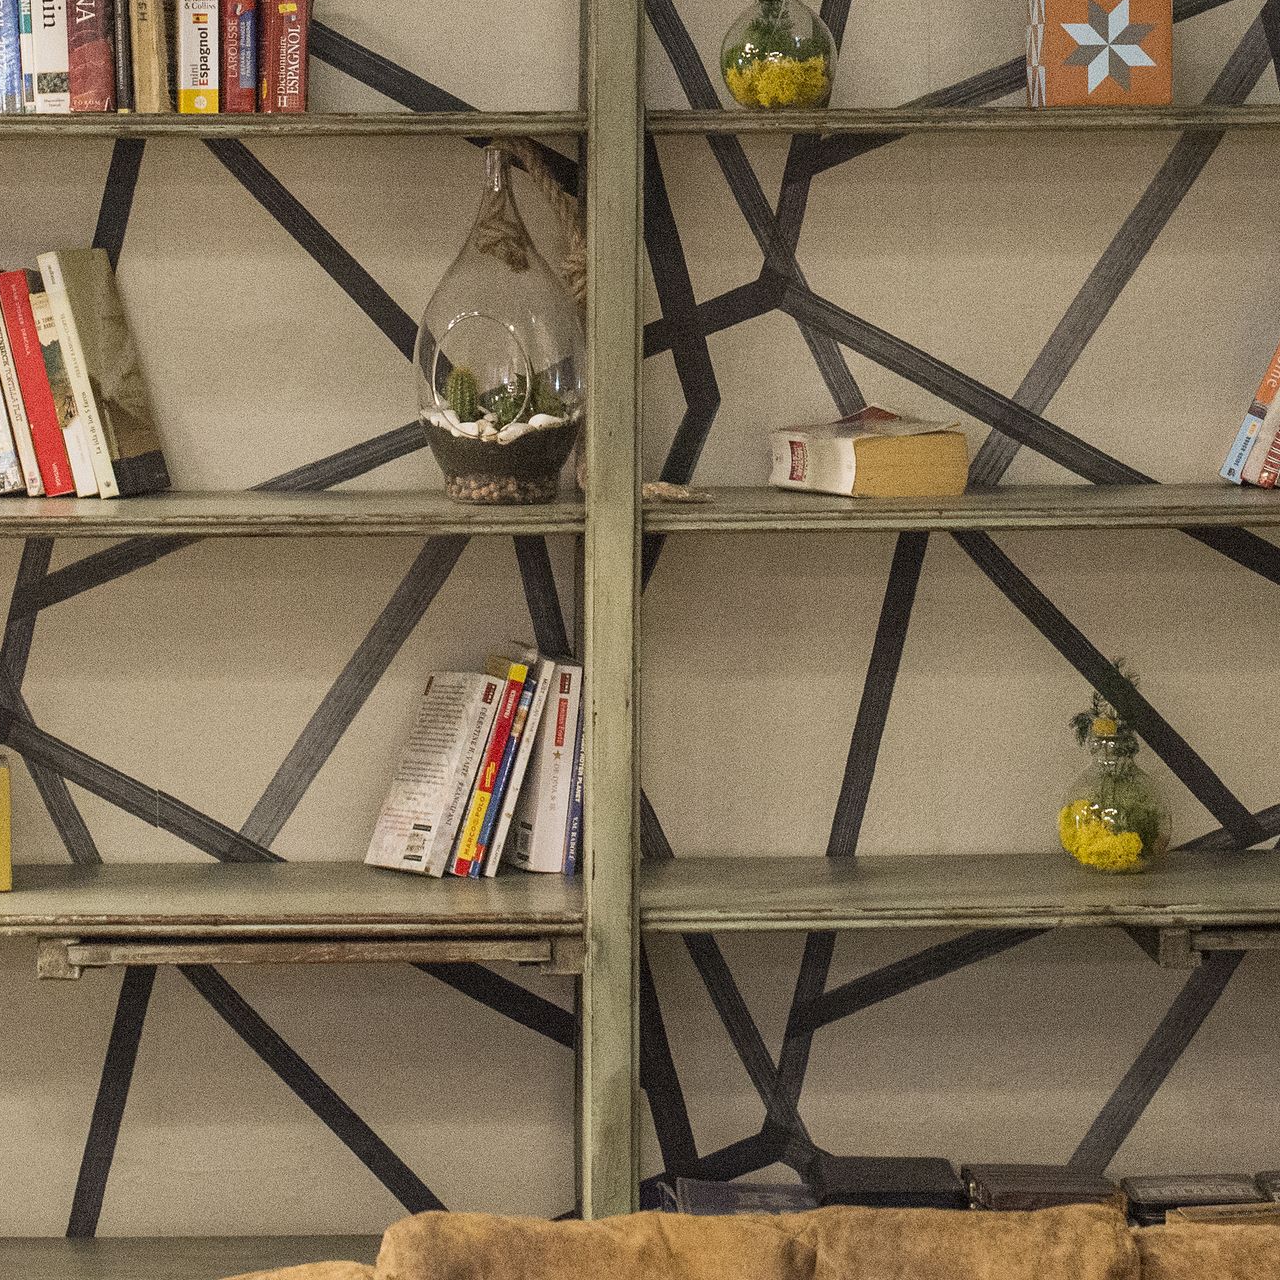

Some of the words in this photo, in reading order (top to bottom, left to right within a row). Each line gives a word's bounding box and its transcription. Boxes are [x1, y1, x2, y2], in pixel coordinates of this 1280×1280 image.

[197, 26, 210, 85] Espagnol
[226, 17, 237, 77] LAROUSSE
[285, 24, 300, 94] ESPAGNOL
[189, 62, 198, 86] mini
[276, 34, 287, 95] Dictionnaire
[12, 403, 24, 423] FLAT
[86, 414, 94, 424] los
[88, 424, 96, 433] de
[90, 432, 99, 445] isla
[94, 446, 101, 454] La
[463, 824, 477, 856] MARCO
[473, 793, 487, 817] POLO
